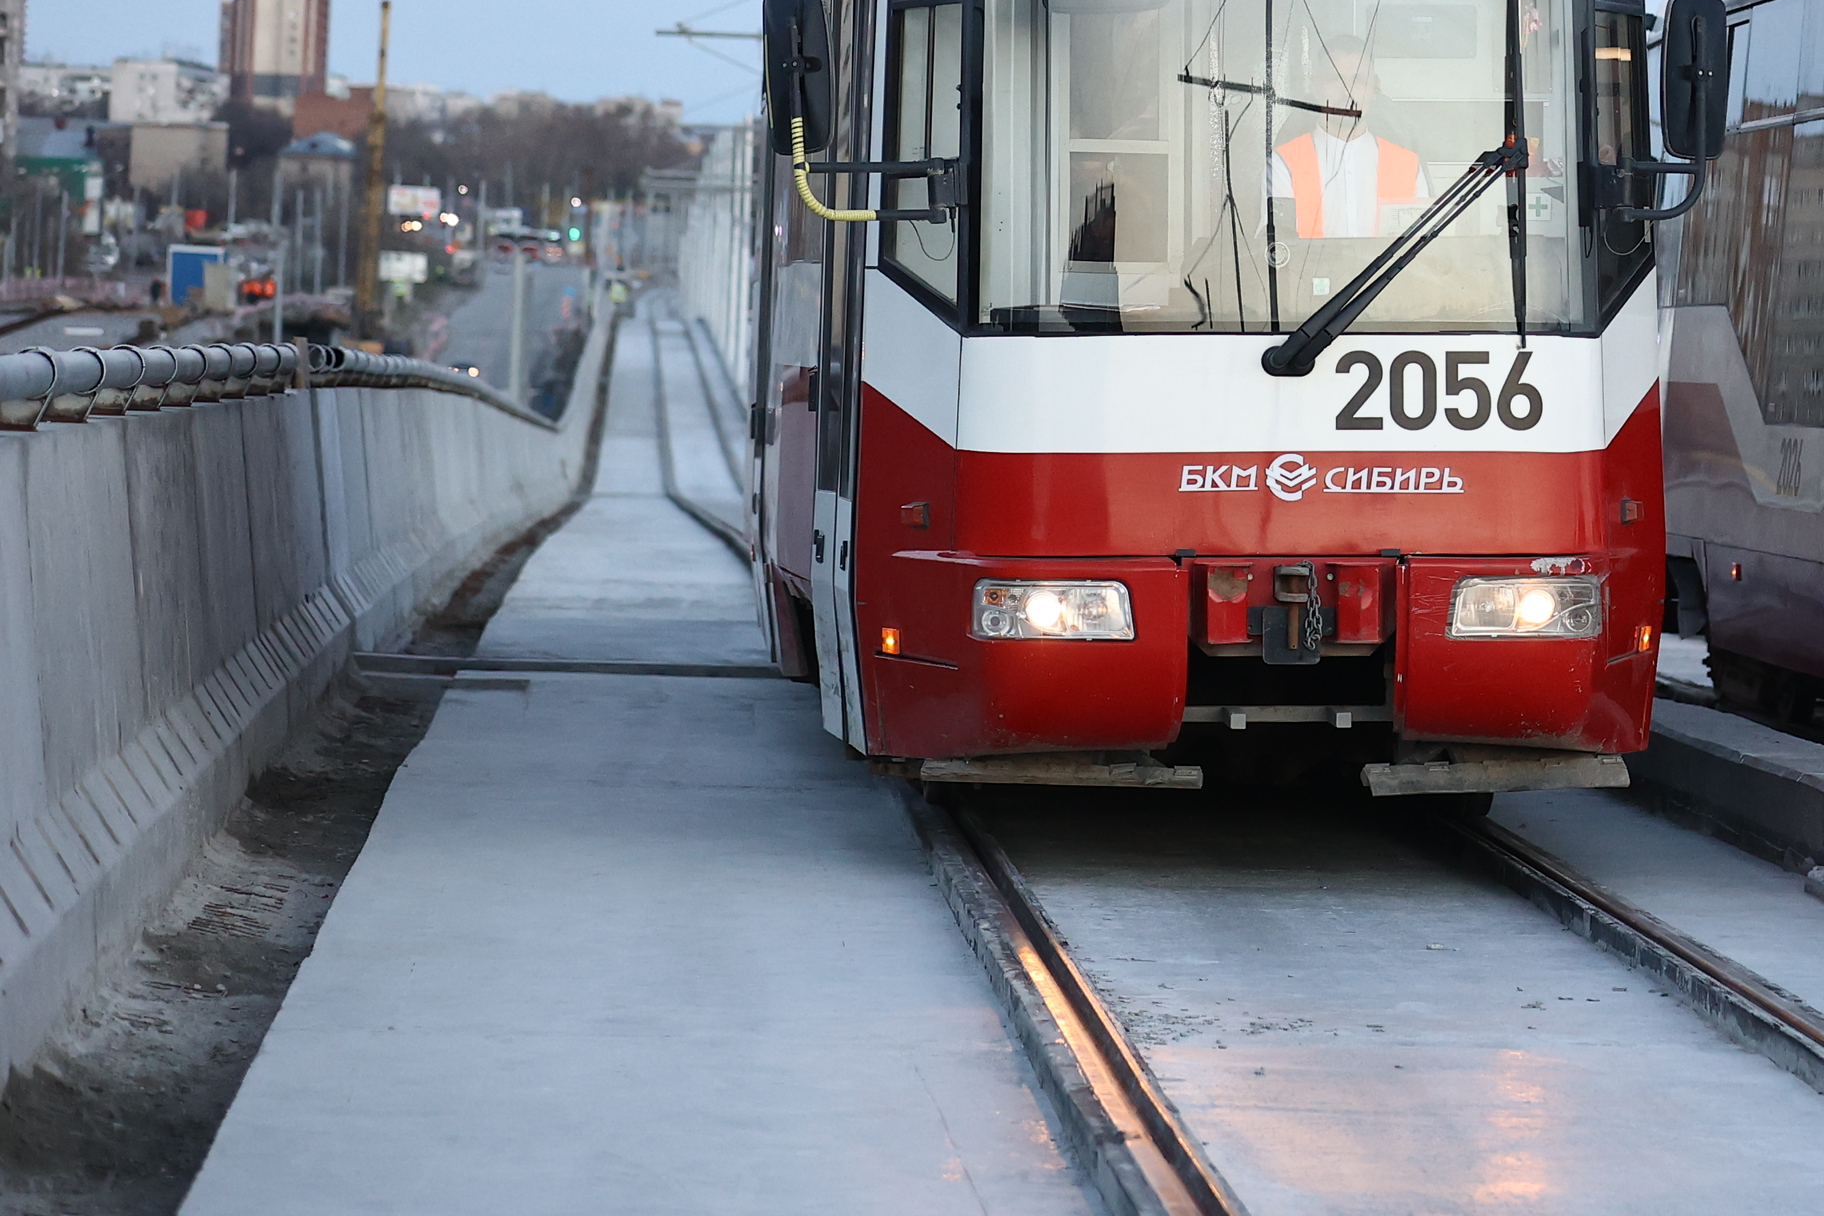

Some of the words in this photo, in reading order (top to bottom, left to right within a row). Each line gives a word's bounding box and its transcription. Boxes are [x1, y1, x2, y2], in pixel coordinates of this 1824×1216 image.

[1335, 350, 1543, 431] 2056
[1178, 464, 1258, 491] БКМ
[1323, 467, 1464, 493] СИБИРЬ
[1776, 437, 1804, 497] 2026
